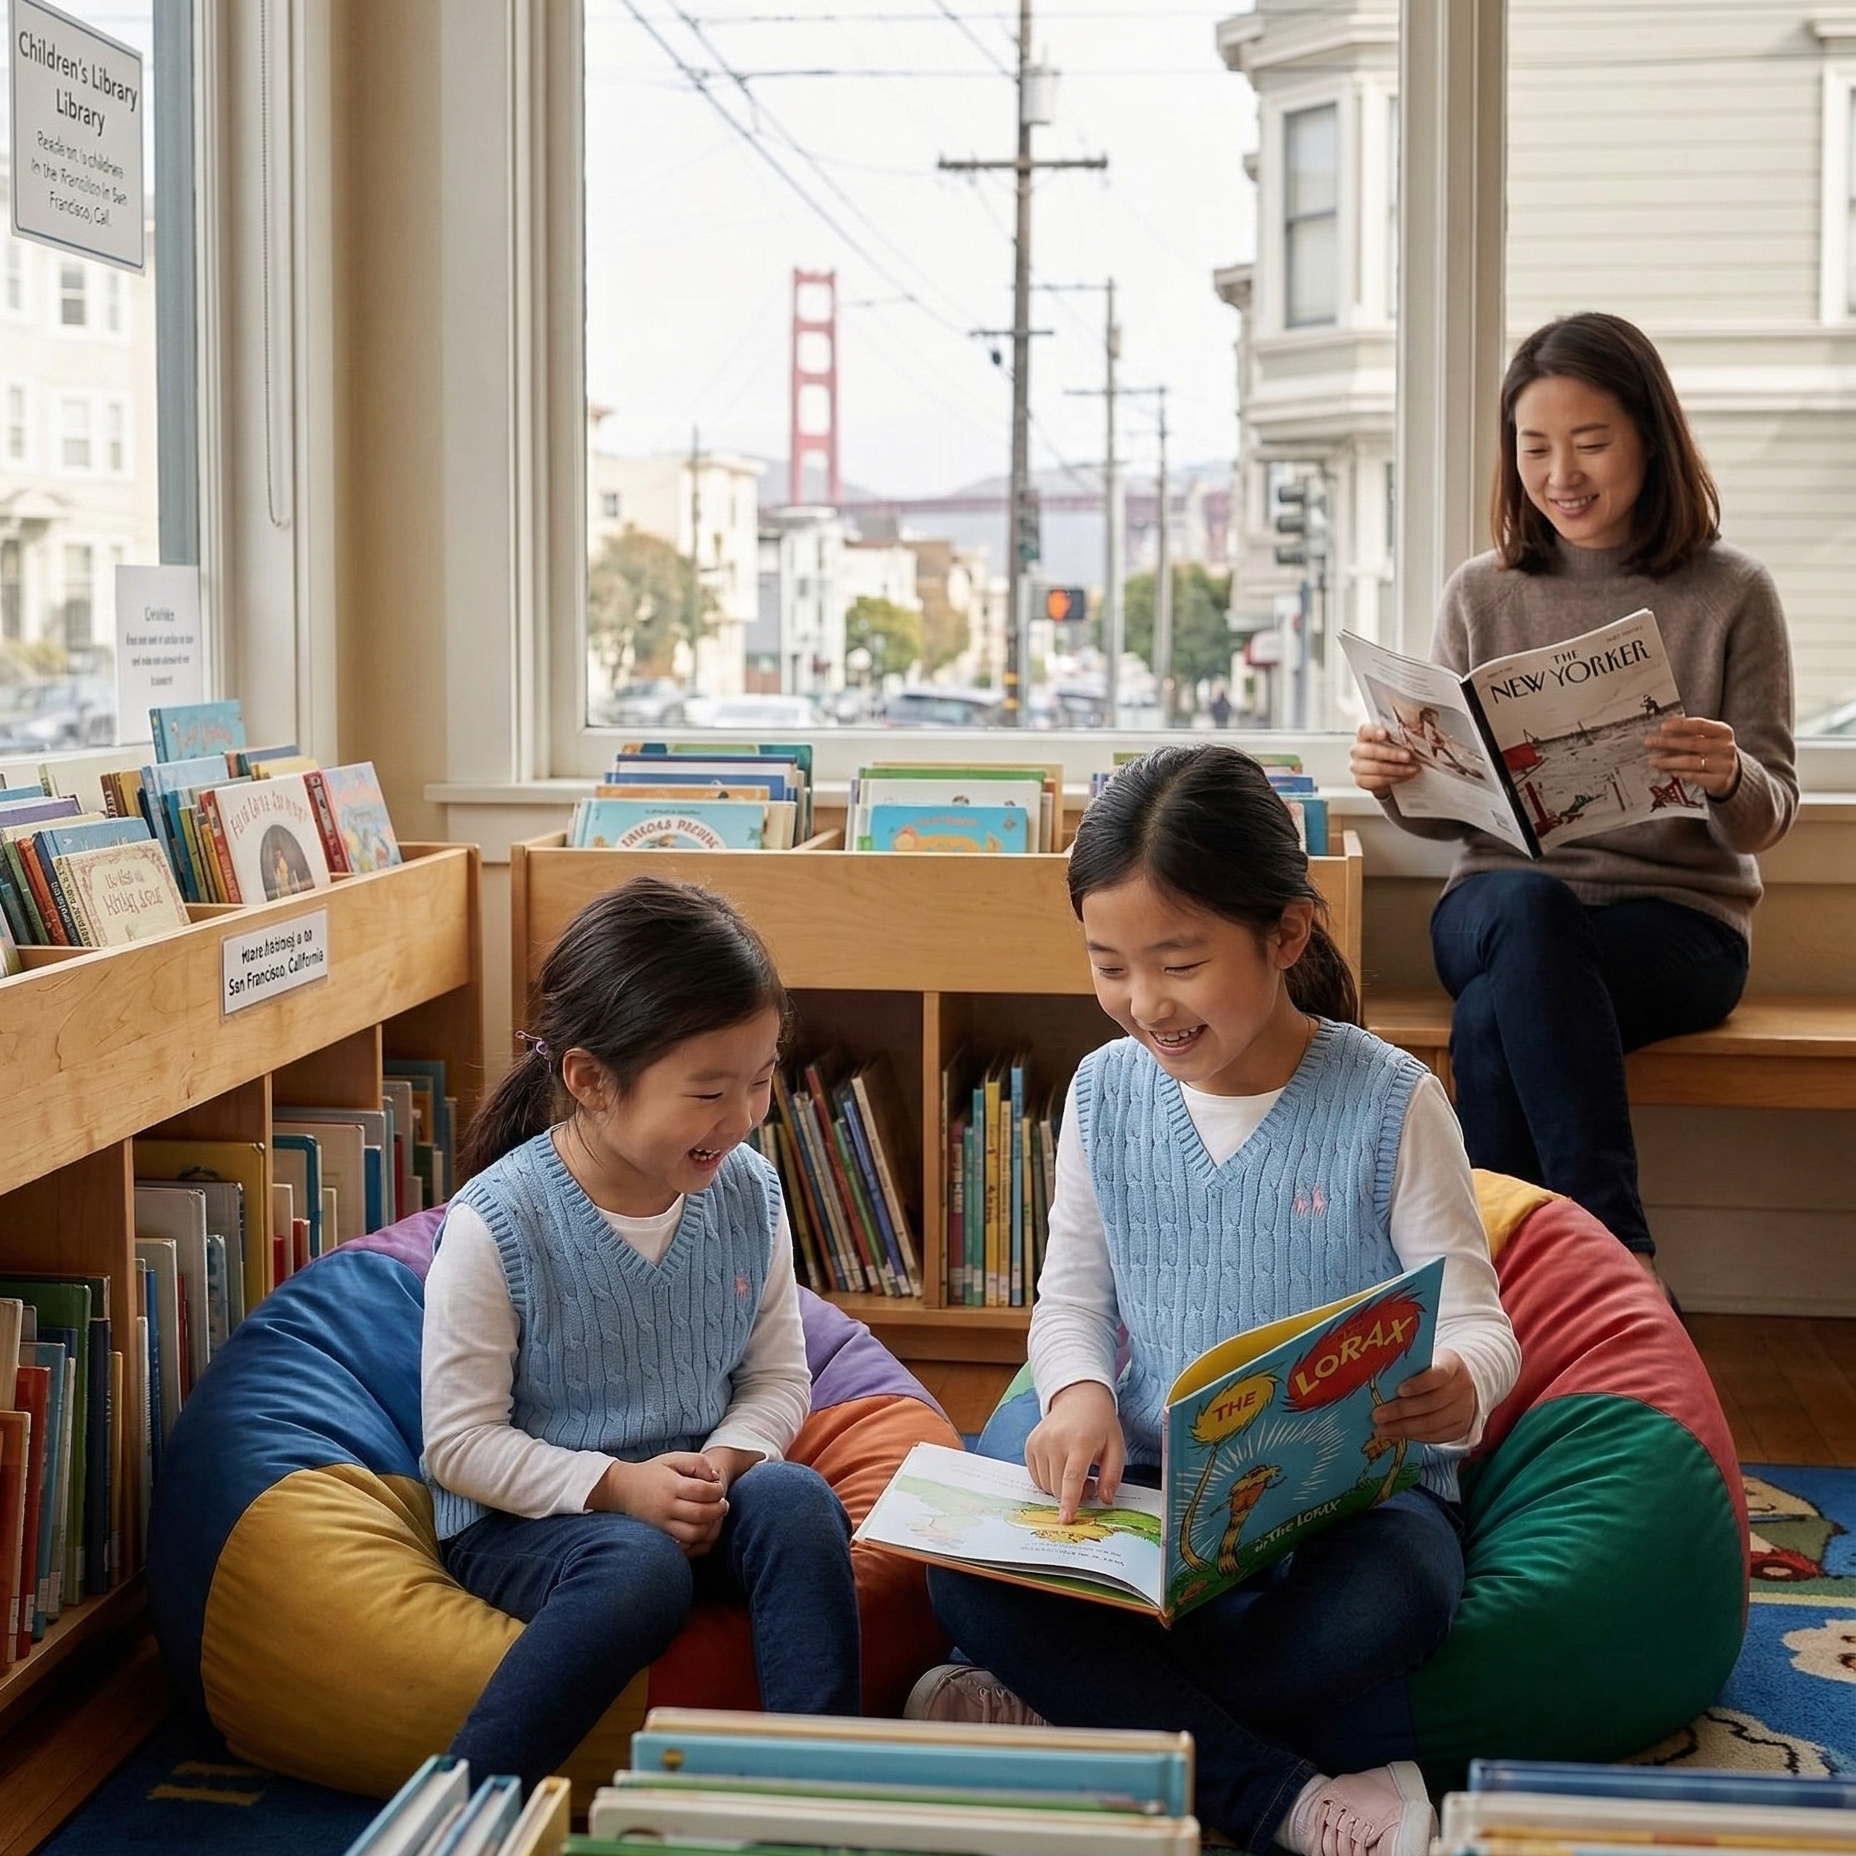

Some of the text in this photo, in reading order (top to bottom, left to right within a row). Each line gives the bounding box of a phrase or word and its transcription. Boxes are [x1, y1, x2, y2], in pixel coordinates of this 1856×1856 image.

[18, 31, 138, 113] Children's Library
[56, 88, 106, 137] Library
[1490, 638, 1652, 704] NEW YORKER
[1553, 649, 1578, 665] THE
[1295, 1316, 1413, 1396] LORAX
[1212, 1390, 1257, 1423] THE
